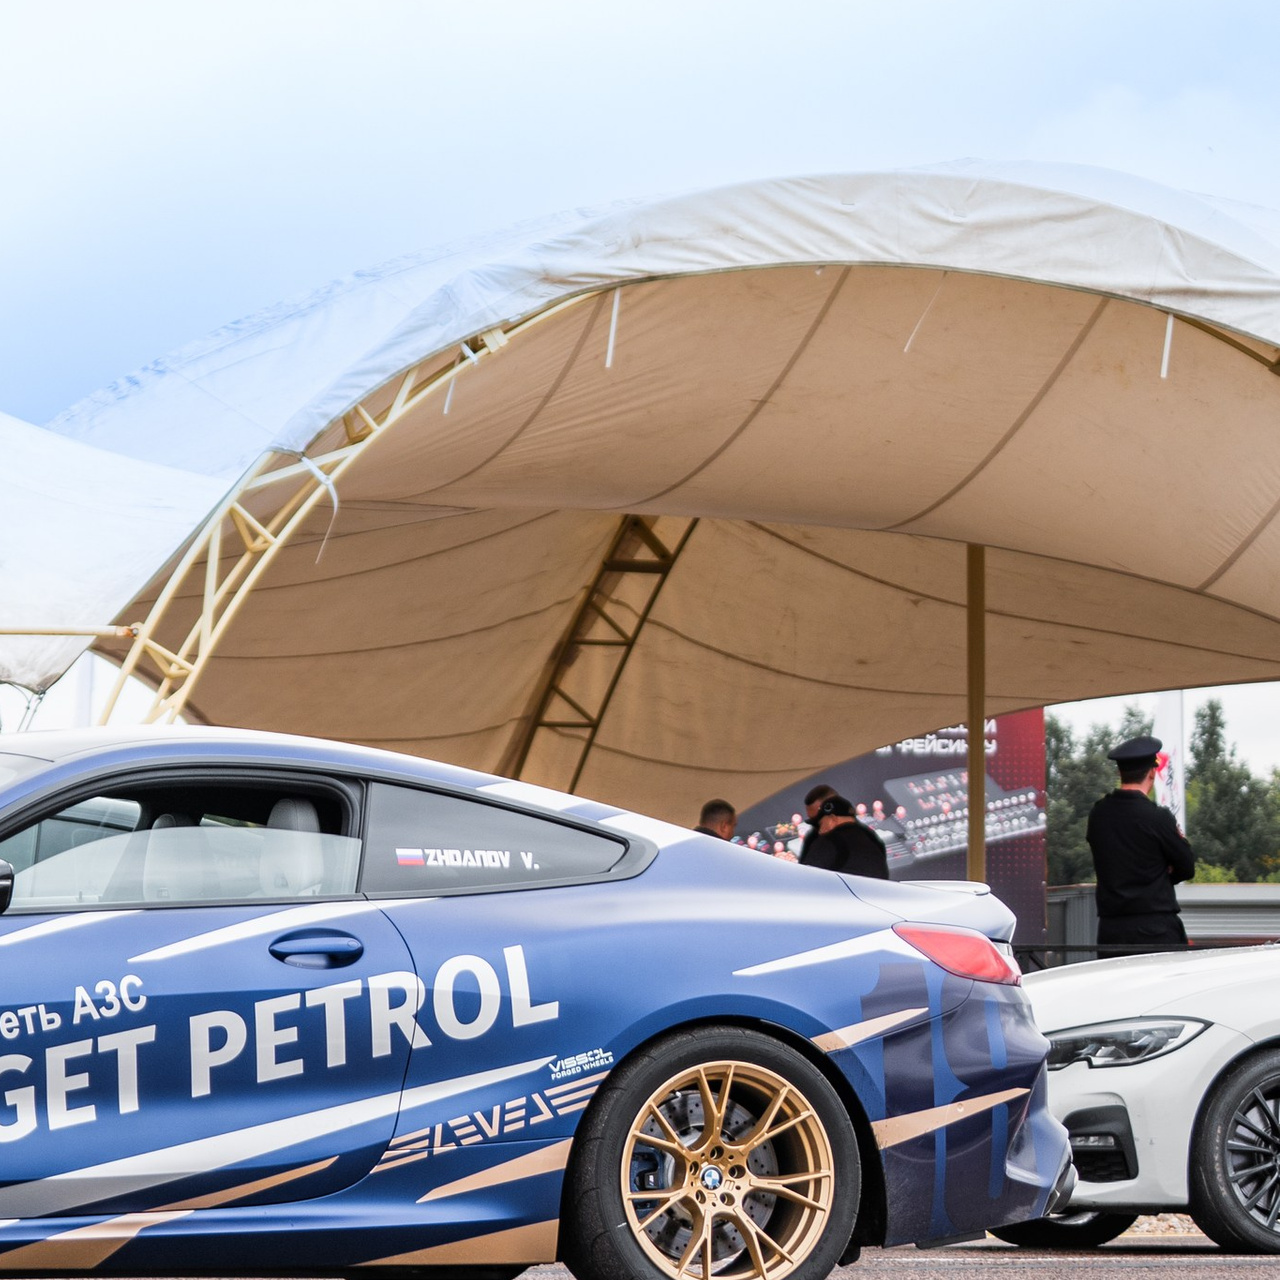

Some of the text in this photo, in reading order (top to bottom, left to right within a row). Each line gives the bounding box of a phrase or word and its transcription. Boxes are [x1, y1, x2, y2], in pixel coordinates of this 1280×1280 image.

[424, 848, 540, 870] ZHDANOV V.
[72, 974, 148, 1025] АЗС
[189, 944, 559, 1098] PETROL
[548, 1047, 613, 1072] VISSOL
[551, 1056, 614, 1080] FORGED WHEELS
